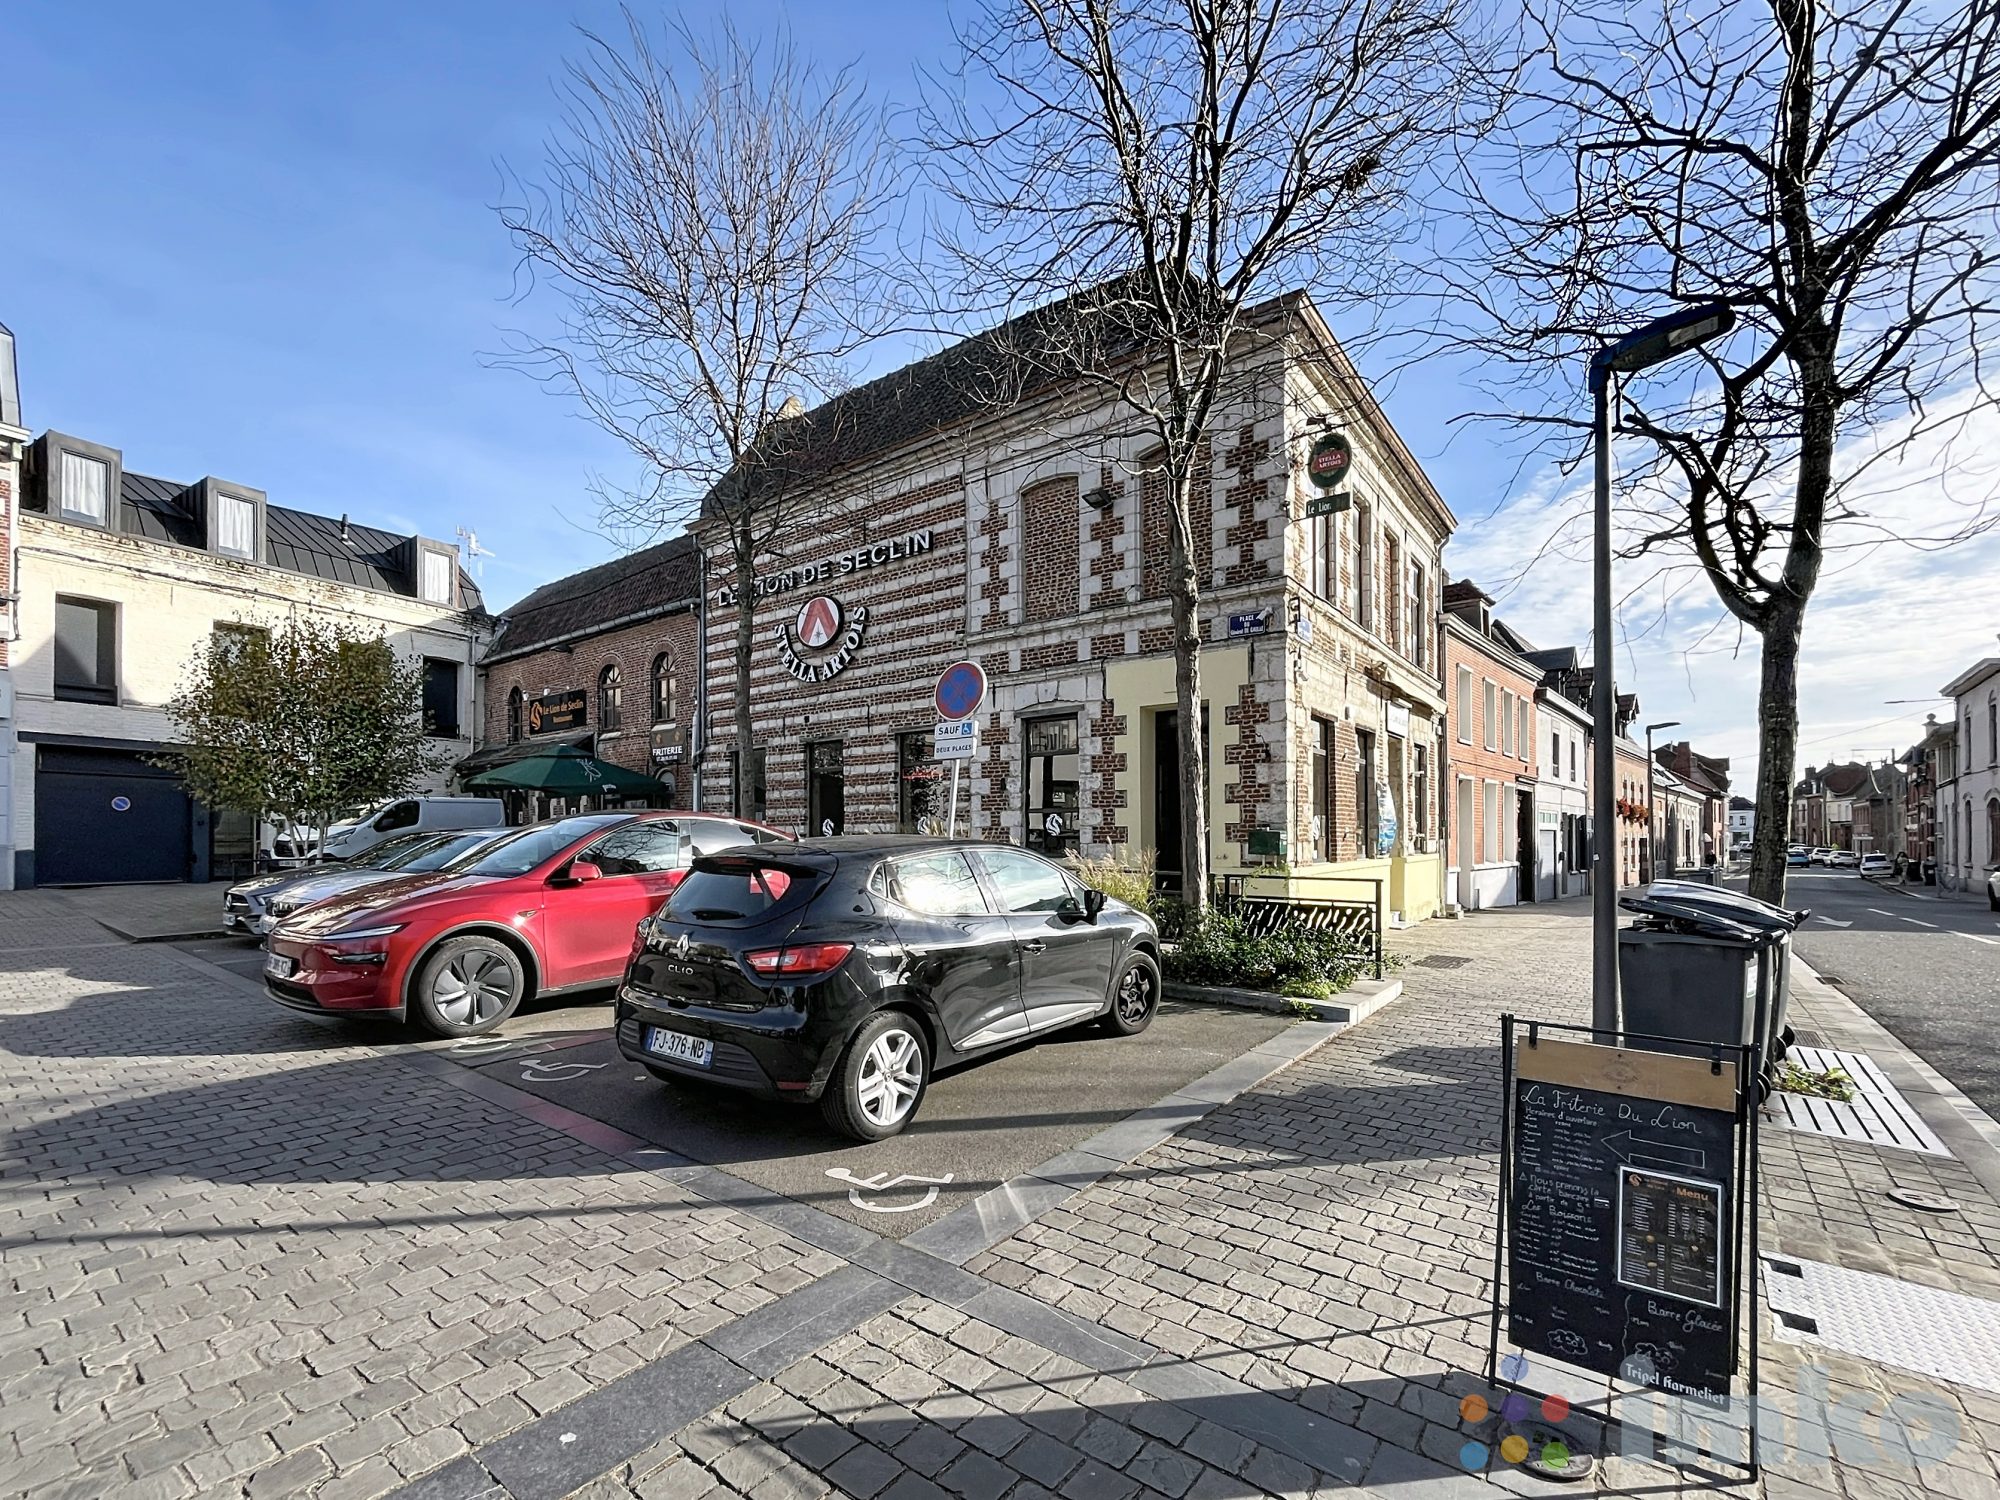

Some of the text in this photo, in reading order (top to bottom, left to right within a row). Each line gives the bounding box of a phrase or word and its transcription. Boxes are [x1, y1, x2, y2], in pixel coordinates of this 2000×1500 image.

[1318, 453, 1341, 463] STELLA
[1319, 460, 1342, 468] ARTOIS
[1307, 504, 1315, 515] Le
[802, 561, 832, 584] DE
[839, 530, 932, 573] SECLIN
[1239, 614, 1254, 622] PLACE
[775, 606, 867, 683] STELLA ARTOIS
[938, 725, 961, 736] SAUF
[652, 745, 683, 756] FRITERIE
[936, 744, 972, 754] DEUX PLACES
[667, 964, 694, 975] CLIO
[653, 1030, 705, 1059] FJ-376-NB
[1520, 1085, 1701, 1133] La Friterie Du Lion
[1676, 1186, 1709, 1201] Menu
[1521, 1199, 1542, 1211] Les
[1647, 1300, 1681, 1321] Barre
[1625, 1362, 1725, 1405] Tripel Karmeliet
